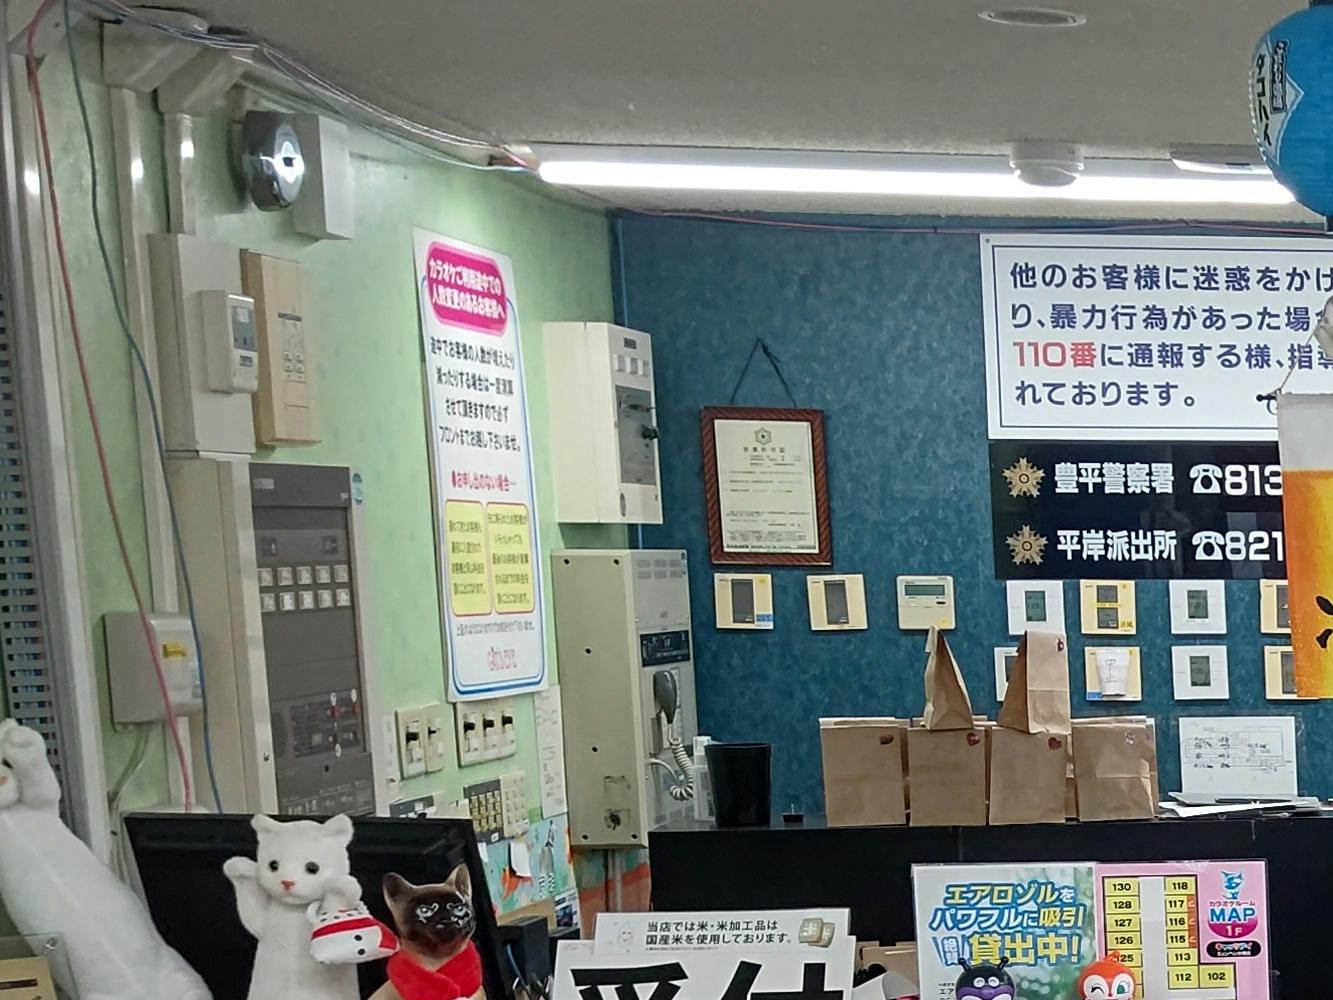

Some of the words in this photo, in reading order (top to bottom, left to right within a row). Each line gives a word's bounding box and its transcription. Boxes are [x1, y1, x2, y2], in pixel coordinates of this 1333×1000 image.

[1010, 303, 1329, 331] り、暴力行為があった場
[1015, 380, 1196, 407] れております。
[1055, 462, 1174, 495] 豊平警察署
[1057, 529, 1177, 562] 平岸派出所
[1113, 883, 1131, 891] 130
[1172, 882, 1188, 890] 118
[944, 880, 1076, 906] エアロゾルを
[1114, 901, 1132, 909] 128
[929, 904, 1087, 931] パワフルに吸引
[1210, 908, 1256, 921] MAP
[647, 920, 778, 933] 当店では米・米加工品は
[1226, 925, 1243, 936] 1F
[646, 933, 791, 945] 国産米を使用しております。
[1170, 935, 1186, 943] 115
[969, 931, 1082, 966] 貸出中!
[1175, 953, 1190, 961] 113
[1175, 973, 1191, 981] 112
[1207, 972, 1226, 981] 102
